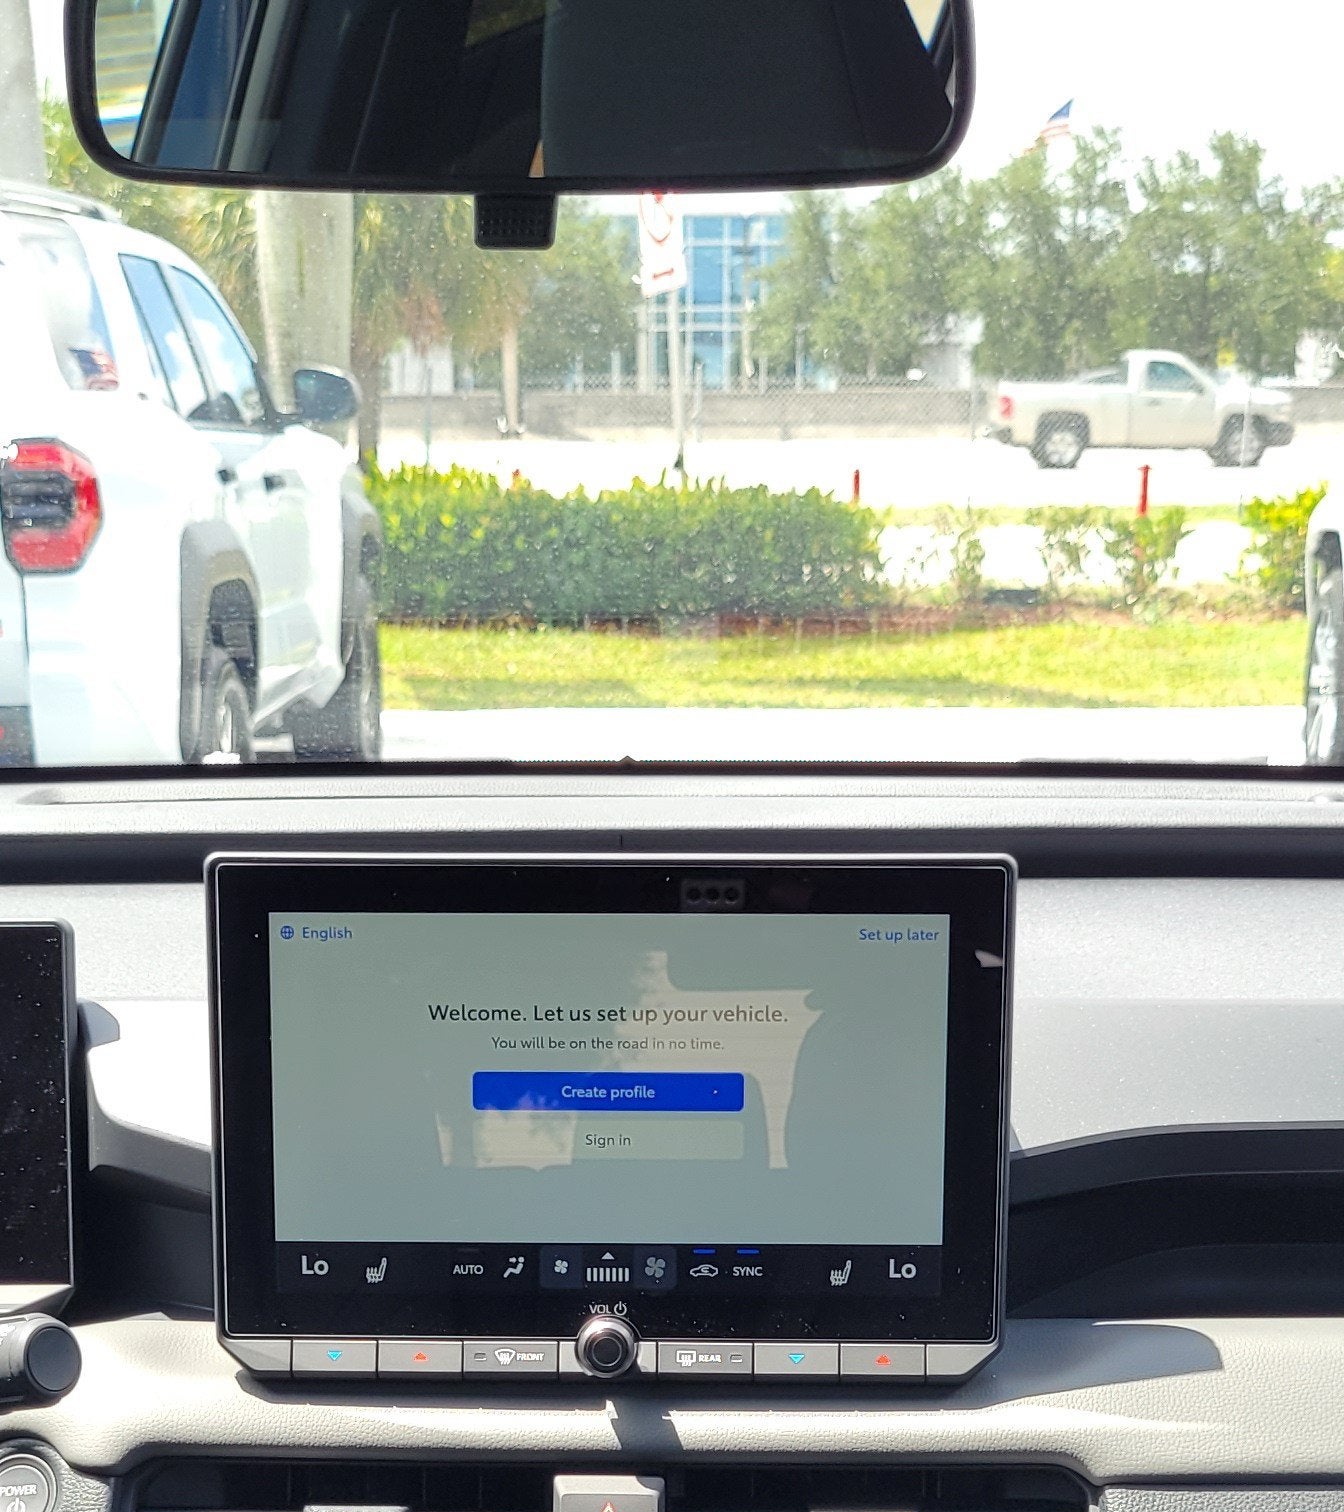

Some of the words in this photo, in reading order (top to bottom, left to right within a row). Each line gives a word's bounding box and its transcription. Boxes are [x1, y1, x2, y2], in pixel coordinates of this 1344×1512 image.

[301, 926, 354, 942] English
[859, 928, 882, 941] Set
[885, 931, 904, 944] up
[907, 928, 940, 941] later
[428, 1004, 527, 1022] Welcome.
[533, 1005, 564, 1022] Let
[569, 1007, 592, 1022] us
[597, 1006, 627, 1022] set
[632, 1008, 658, 1026] up
[663, 1008, 708, 1026] your
[713, 1005, 789, 1023] vehicle.
[491, 1036, 517, 1050] You
[520, 1036, 545, 1050] will
[548, 1036, 566, 1050] be
[569, 1039, 587, 1050] on
[591, 1037, 613, 1050] the
[618, 1037, 649, 1050] road
[652, 1038, 665, 1050] in
[669, 1040, 687, 1051] no
[690, 1038, 725, 1051] time.
[561, 1085, 607, 1099] Create
[610, 1085, 656, 1102] profile
[585, 1133, 616, 1149] Sign
[619, 1134, 632, 1147] in
[301, 1255, 329, 1276] Lo
[452, 1263, 484, 1276] AUTO
[732, 1266, 764, 1277] SYNC
[889, 1258, 917, 1279] Lo
[588, 1304, 612, 1315] VOL
[515, 1352, 545, 1363] FRONT
[698, 1353, 722, 1364] REAR
